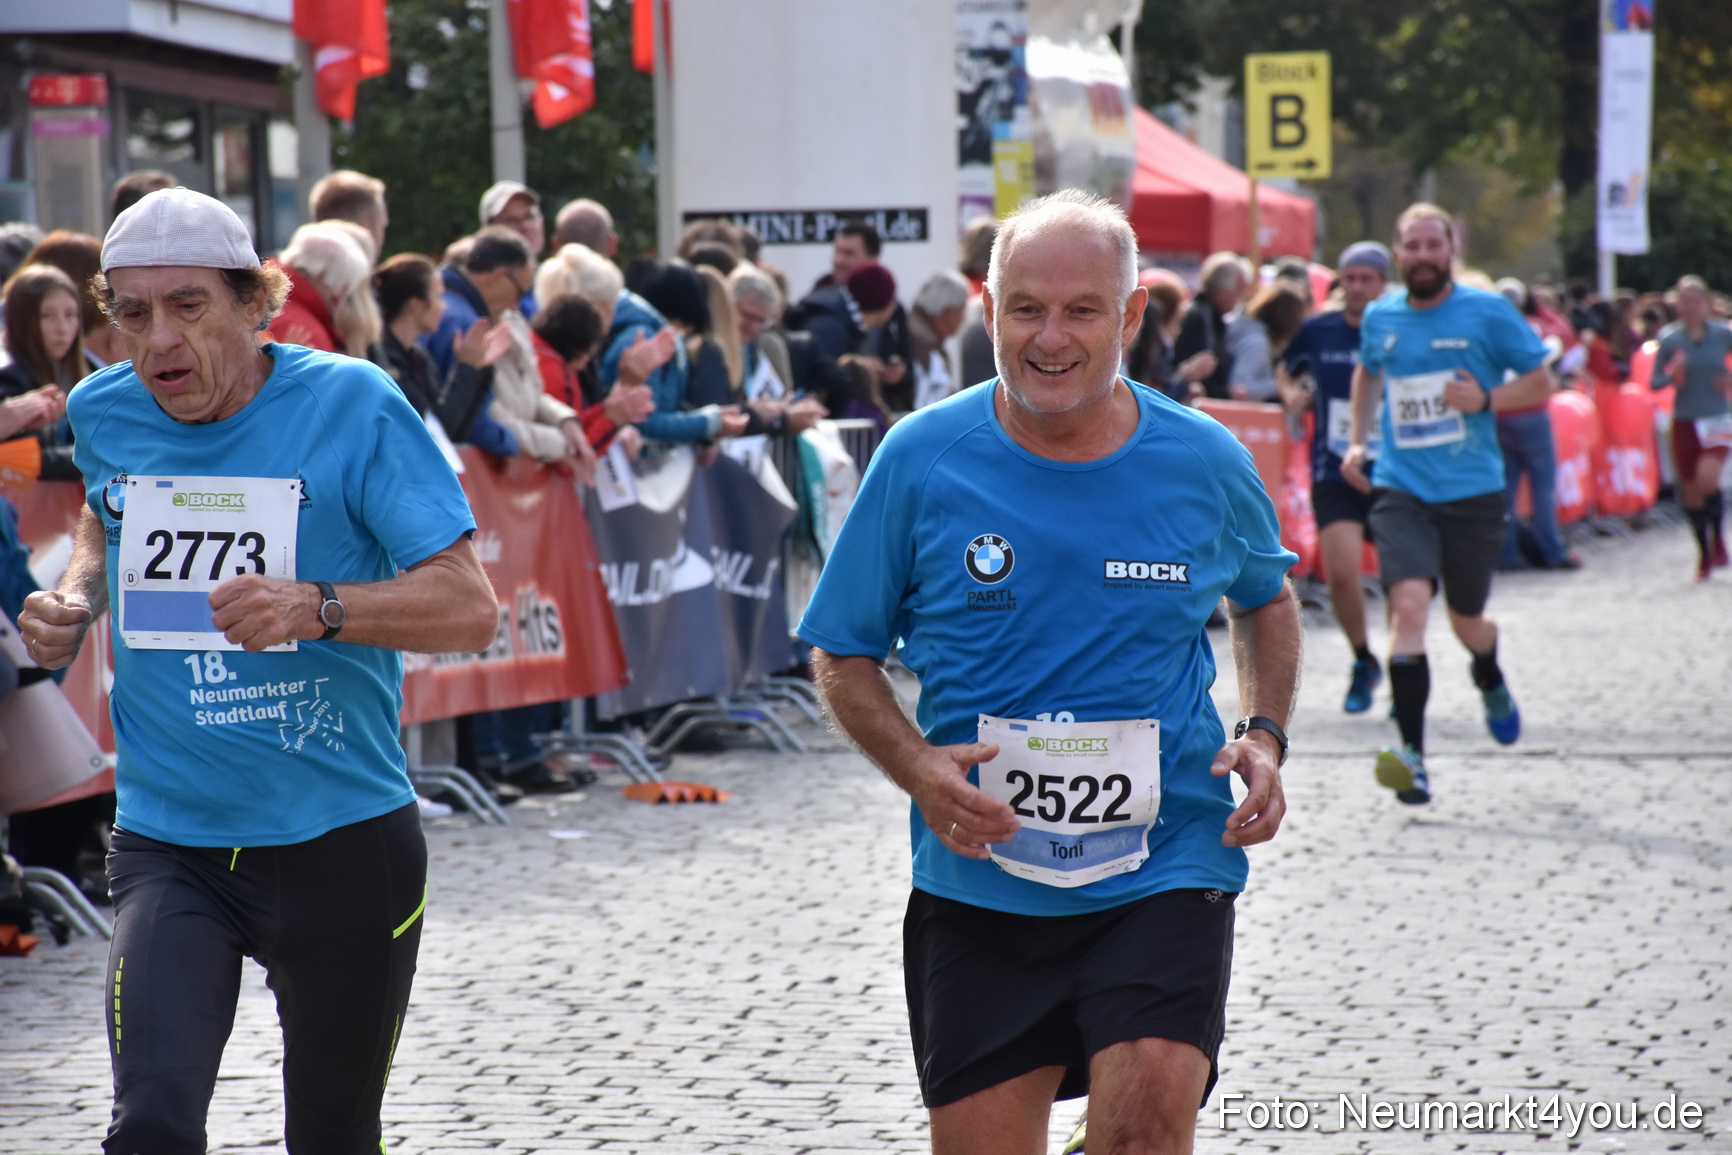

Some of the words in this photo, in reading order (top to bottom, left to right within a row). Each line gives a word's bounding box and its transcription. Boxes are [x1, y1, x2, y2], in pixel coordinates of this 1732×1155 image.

[1271, 94, 1307, 149] B
[188, 493, 246, 507] BOCK
[144, 529, 266, 580] 2773
[969, 536, 1010, 553] BMW
[1104, 560, 1190, 583] BOCK
[967, 589, 1017, 603] PARTL
[968, 602, 1017, 612] Neumarkt
[184, 650, 237, 685] 18.
[190, 680, 307, 705] Neumarkter
[195, 701, 288, 726] Stadtlauf
[314, 700, 331, 718] 2017
[1046, 738, 1108, 752] BOCK
[1006, 769, 1132, 824] 2522
[1049, 840, 1084, 860] Toni
